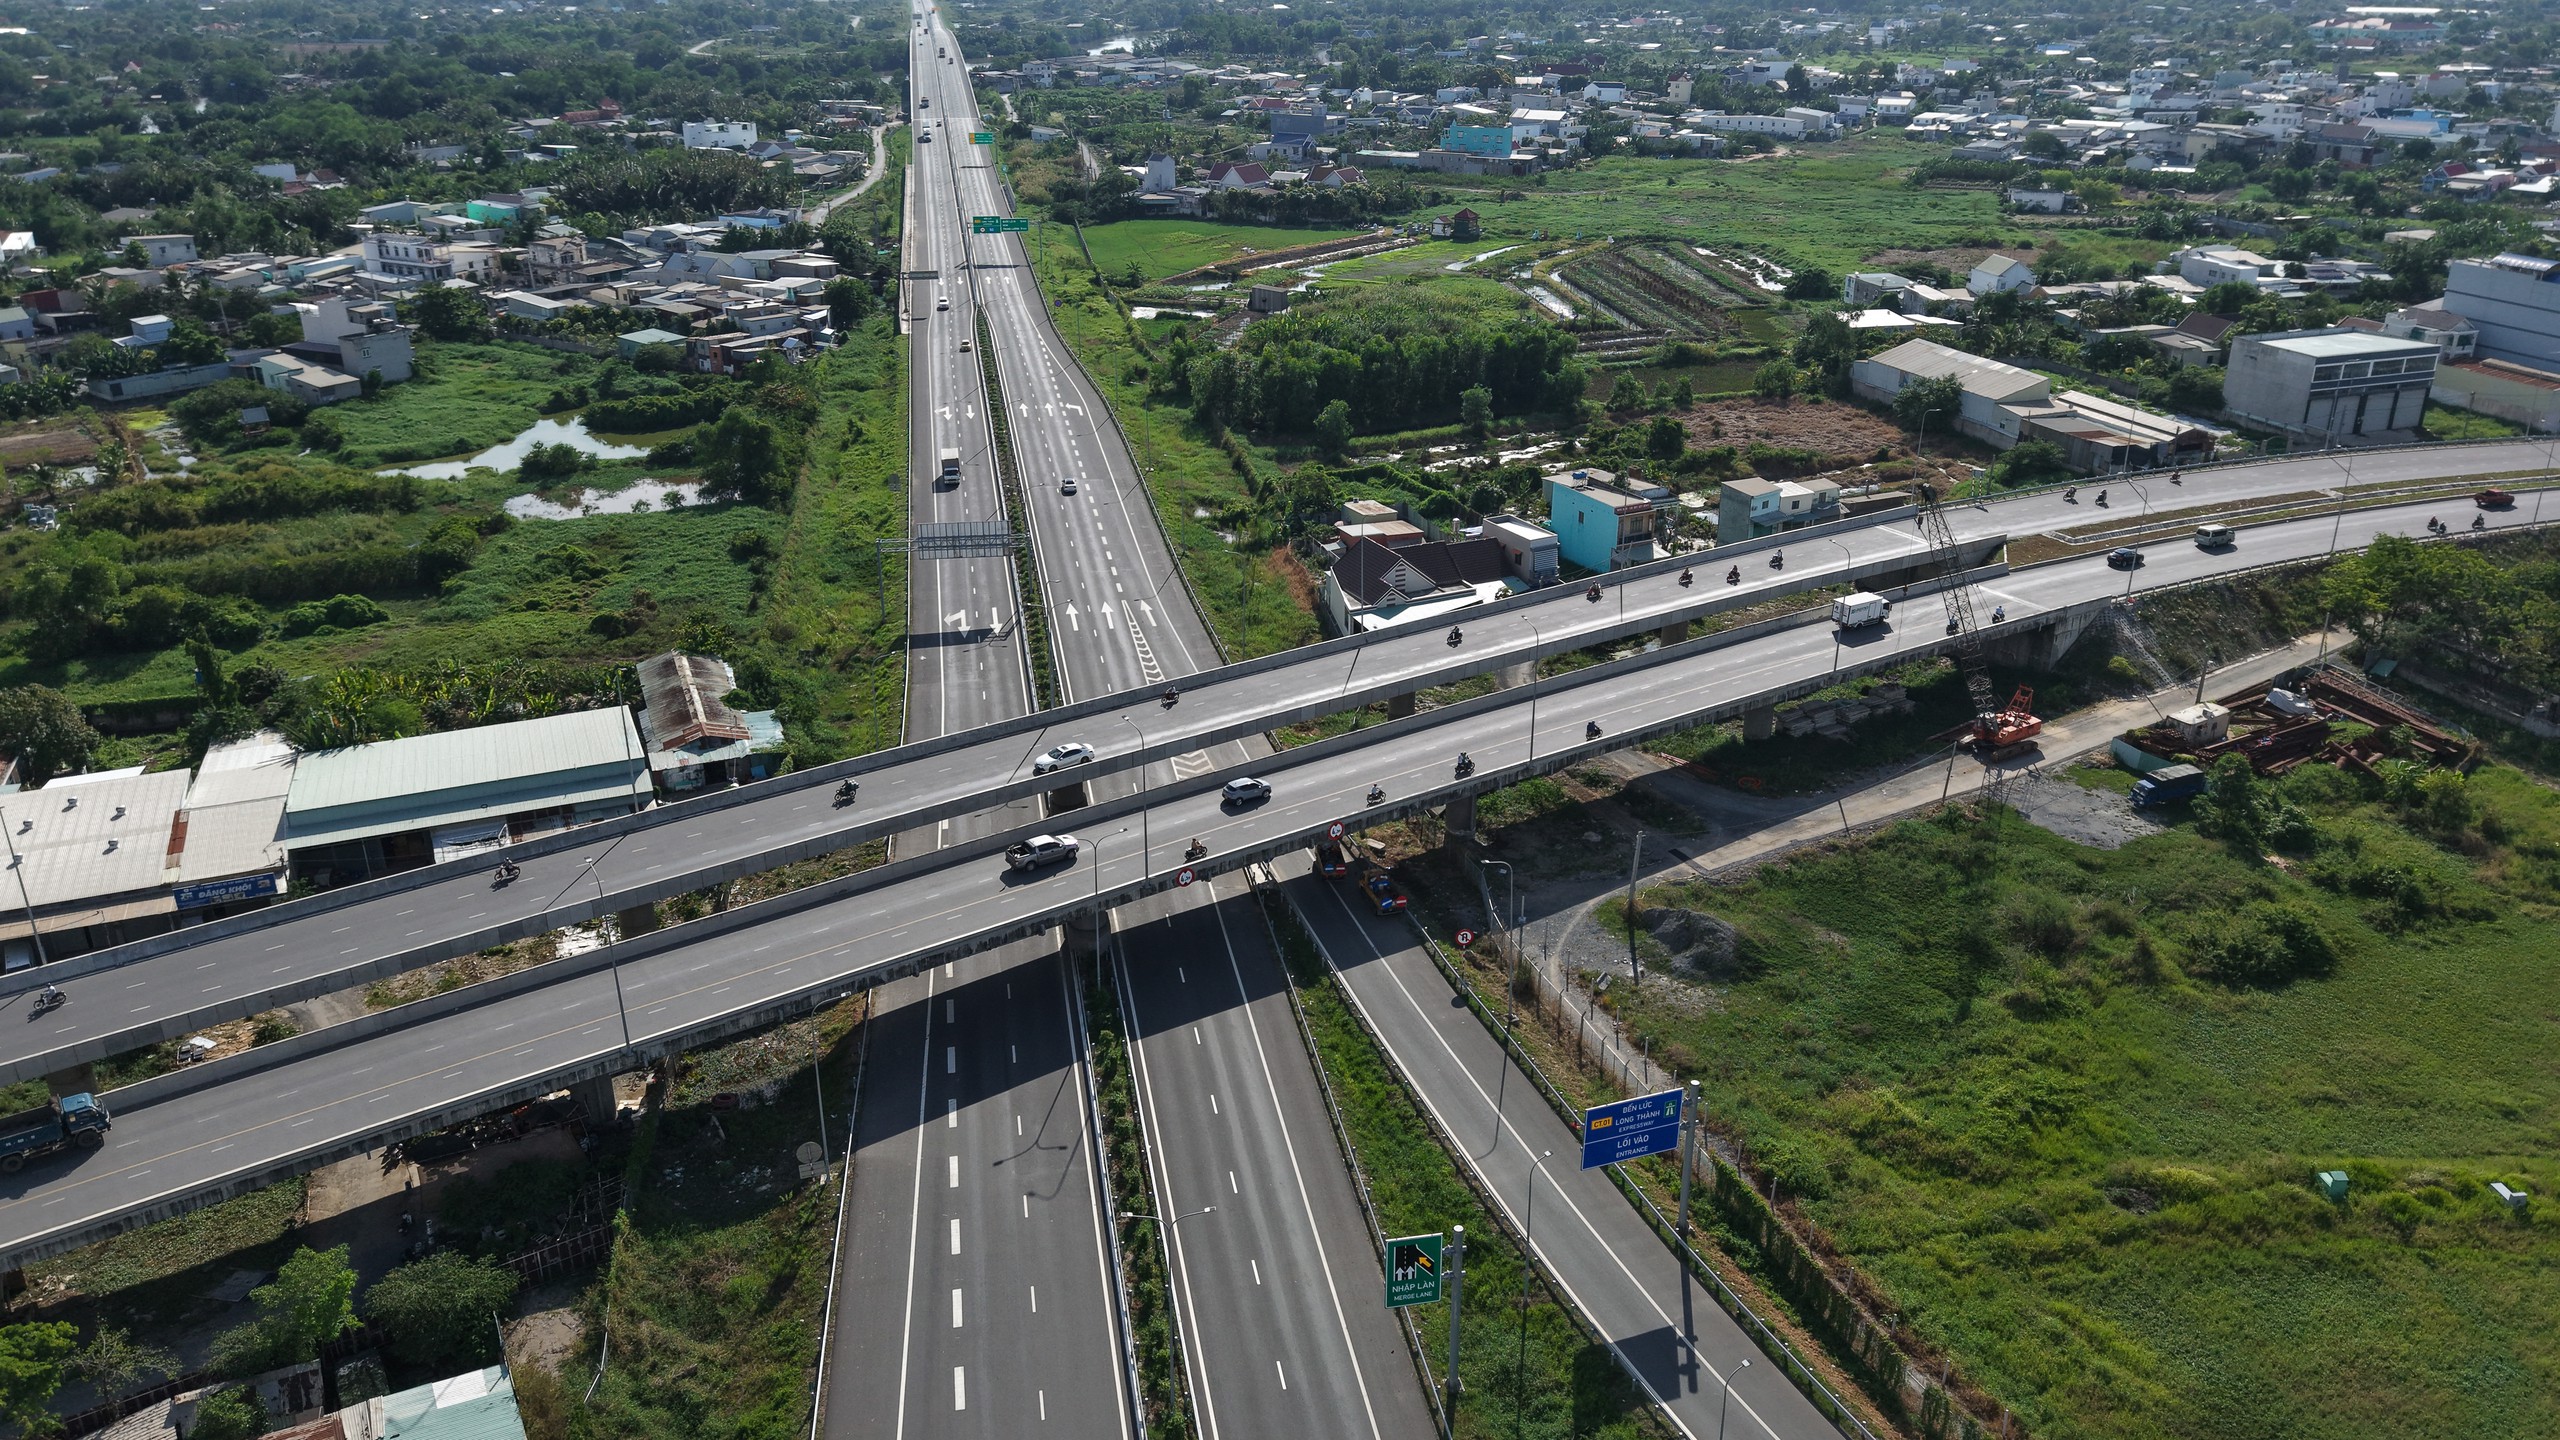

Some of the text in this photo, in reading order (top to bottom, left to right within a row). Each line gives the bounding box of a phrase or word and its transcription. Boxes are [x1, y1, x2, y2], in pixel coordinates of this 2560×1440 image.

[1639, 1100, 1652, 1110] LỨC
[1615, 1110, 1660, 1126] LONG THÀNH
[1618, 1120, 1655, 1132] EXPRESSWAY
[1617, 1134, 1649, 1148] LỐI VÀO
[1616, 1145, 1648, 1158] ENTRANCE
[1392, 1280, 1434, 1293] NHẬP LÀN
[1394, 1293, 1415, 1301] MERGE
